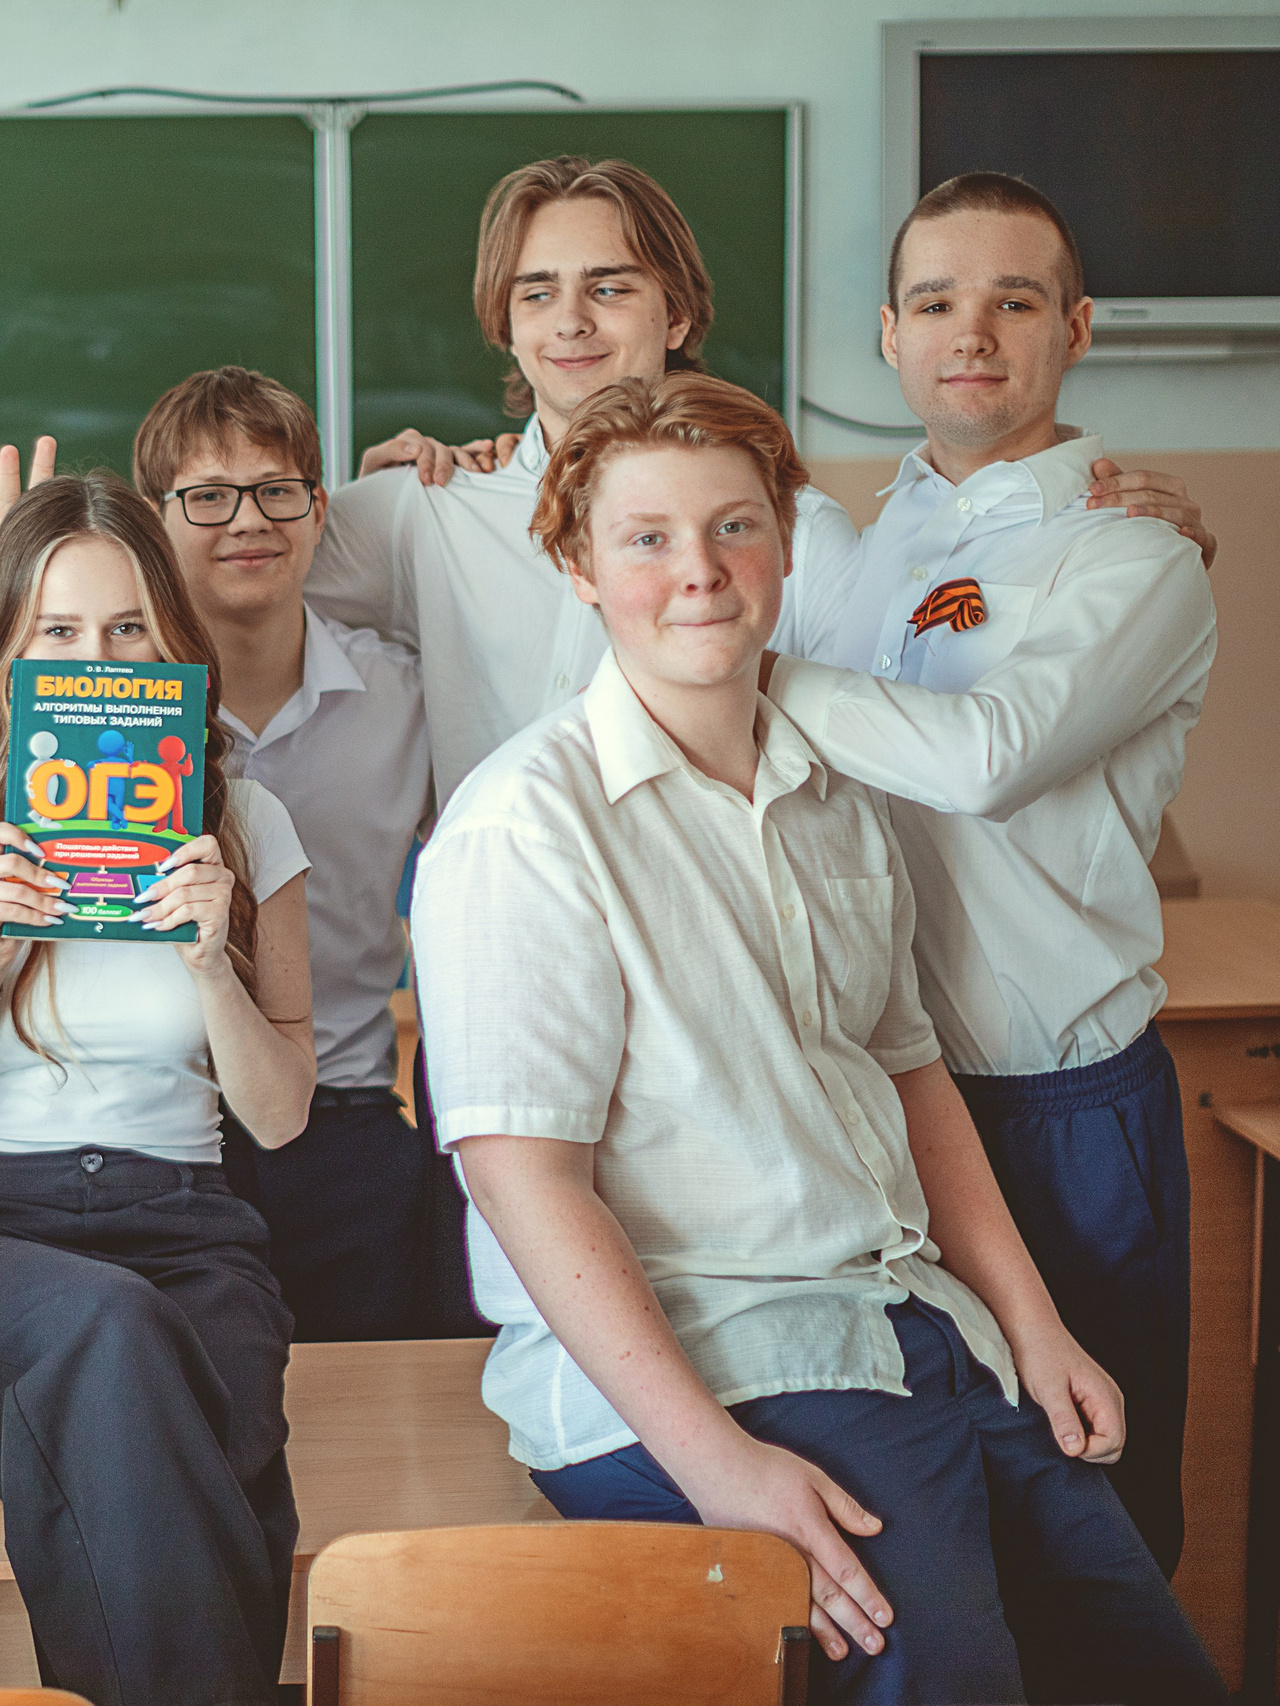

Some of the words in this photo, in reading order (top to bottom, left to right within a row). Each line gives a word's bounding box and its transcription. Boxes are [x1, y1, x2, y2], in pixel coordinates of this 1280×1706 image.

[105, 666, 134, 674] Лаптева
[36, 675, 183, 701] БИОЛОГИЯ
[34, 702, 103, 713] АЛГОРИТМЫ
[105, 704, 183, 716] ВЫПОЛНЕНИЯ
[53, 714, 107, 725] ТИПОВЫХ
[110, 716, 163, 727] ЗАДАНИЙ
[28, 759, 176, 823] ОГЭ
[56, 843, 101, 851] Пошаговые
[101, 844, 139, 852] действия
[81, 906, 98, 915] 100
